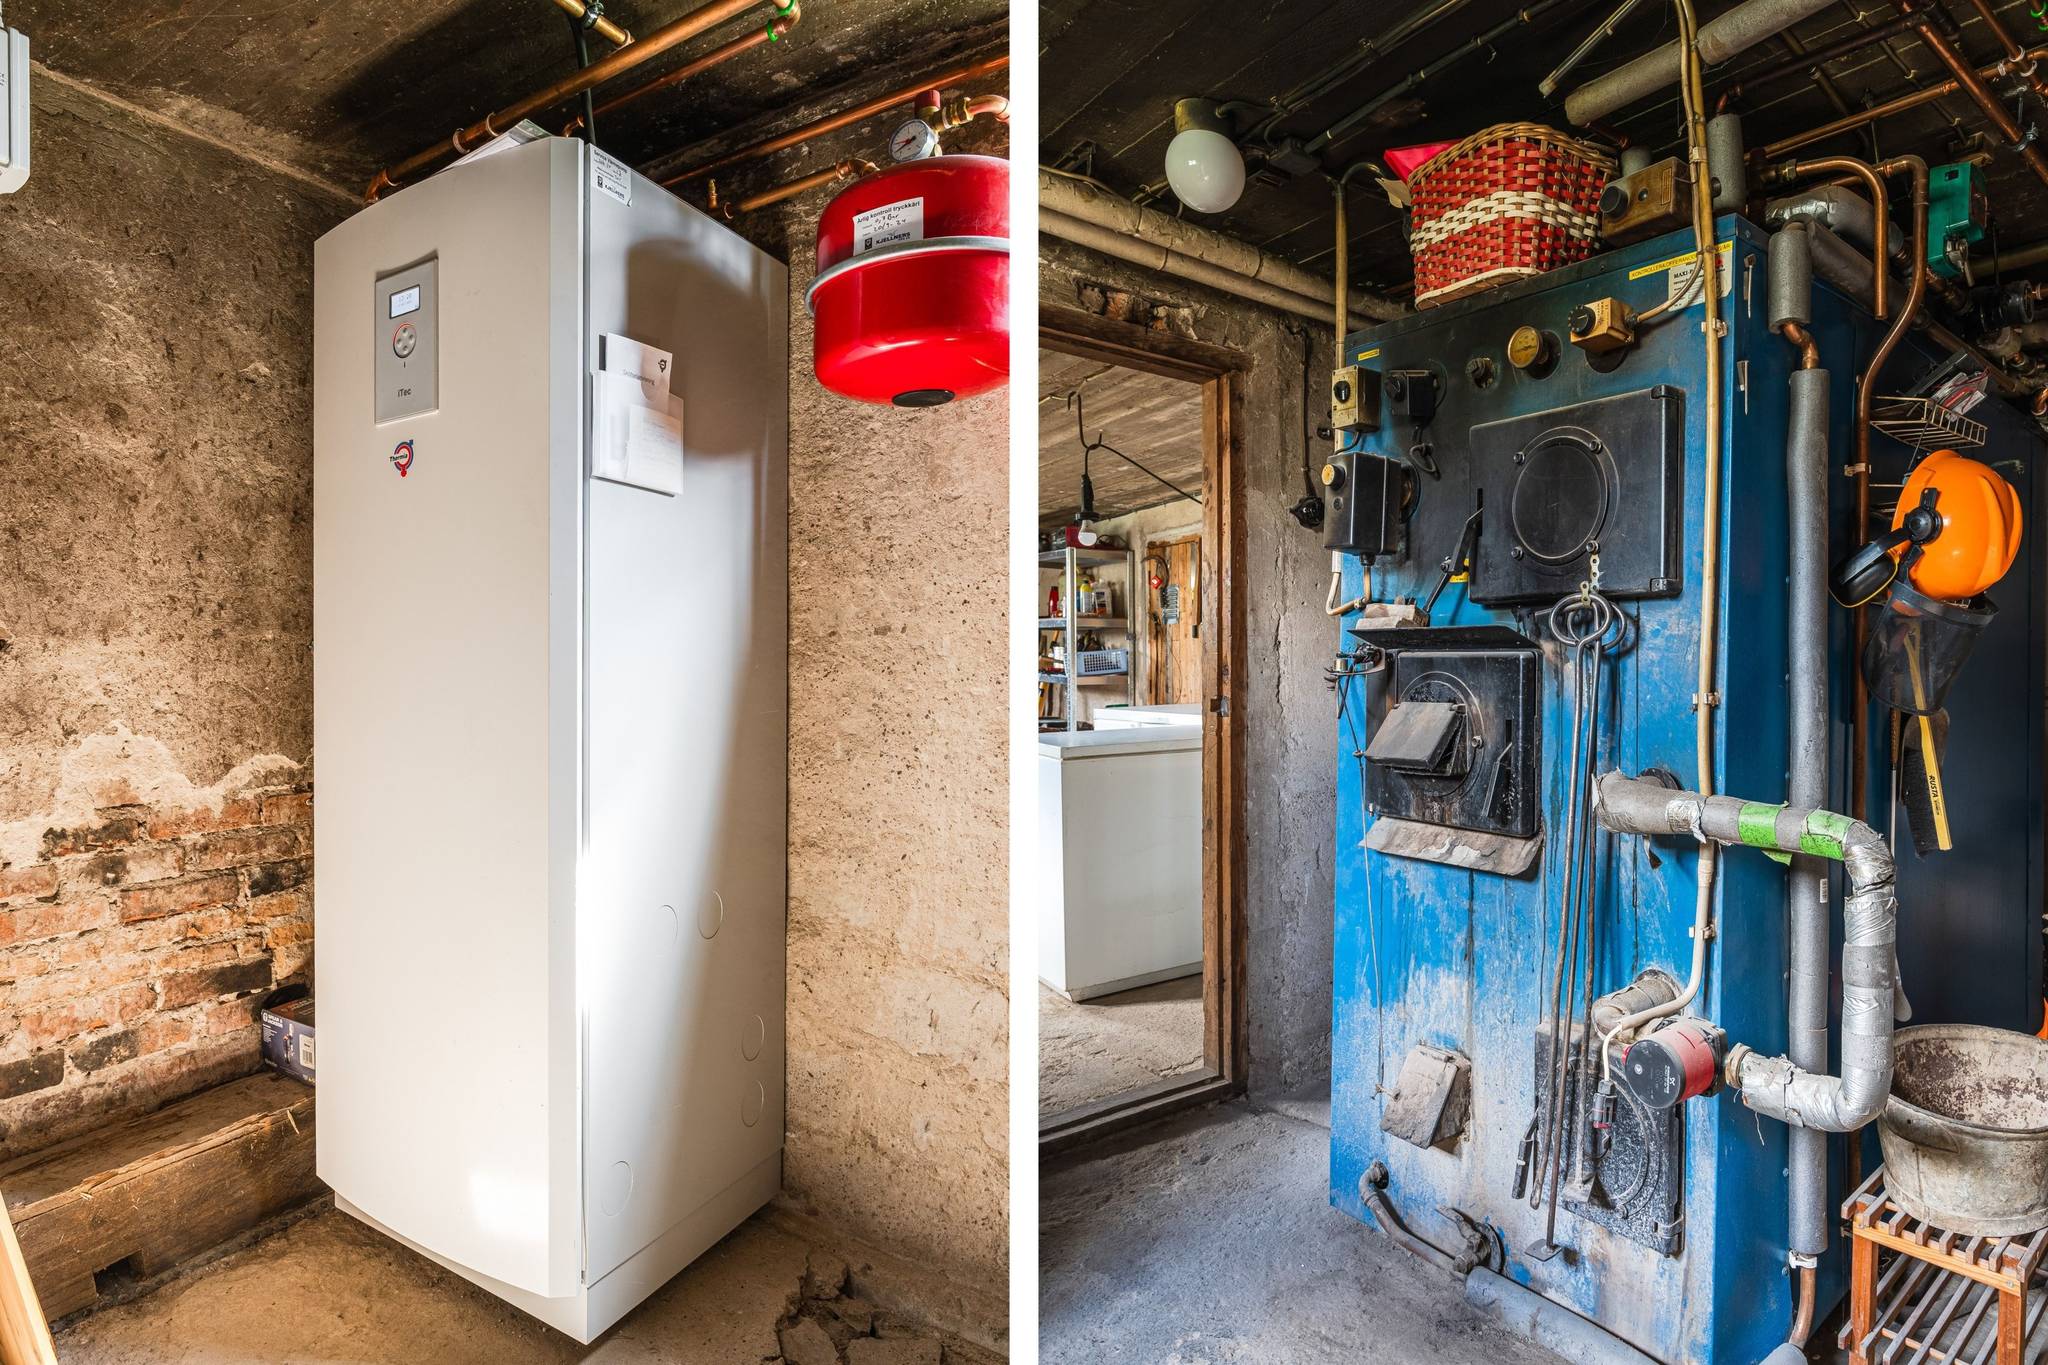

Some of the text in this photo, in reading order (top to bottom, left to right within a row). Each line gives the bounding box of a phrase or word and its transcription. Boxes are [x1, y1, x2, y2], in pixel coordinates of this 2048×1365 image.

[870, 207, 892, 218] kontroll
[893, 201, 920, 212] tryckkärl
[876, 232, 911, 245] KJELLNERS
[1928, 775, 1938, 798] RUSTA
